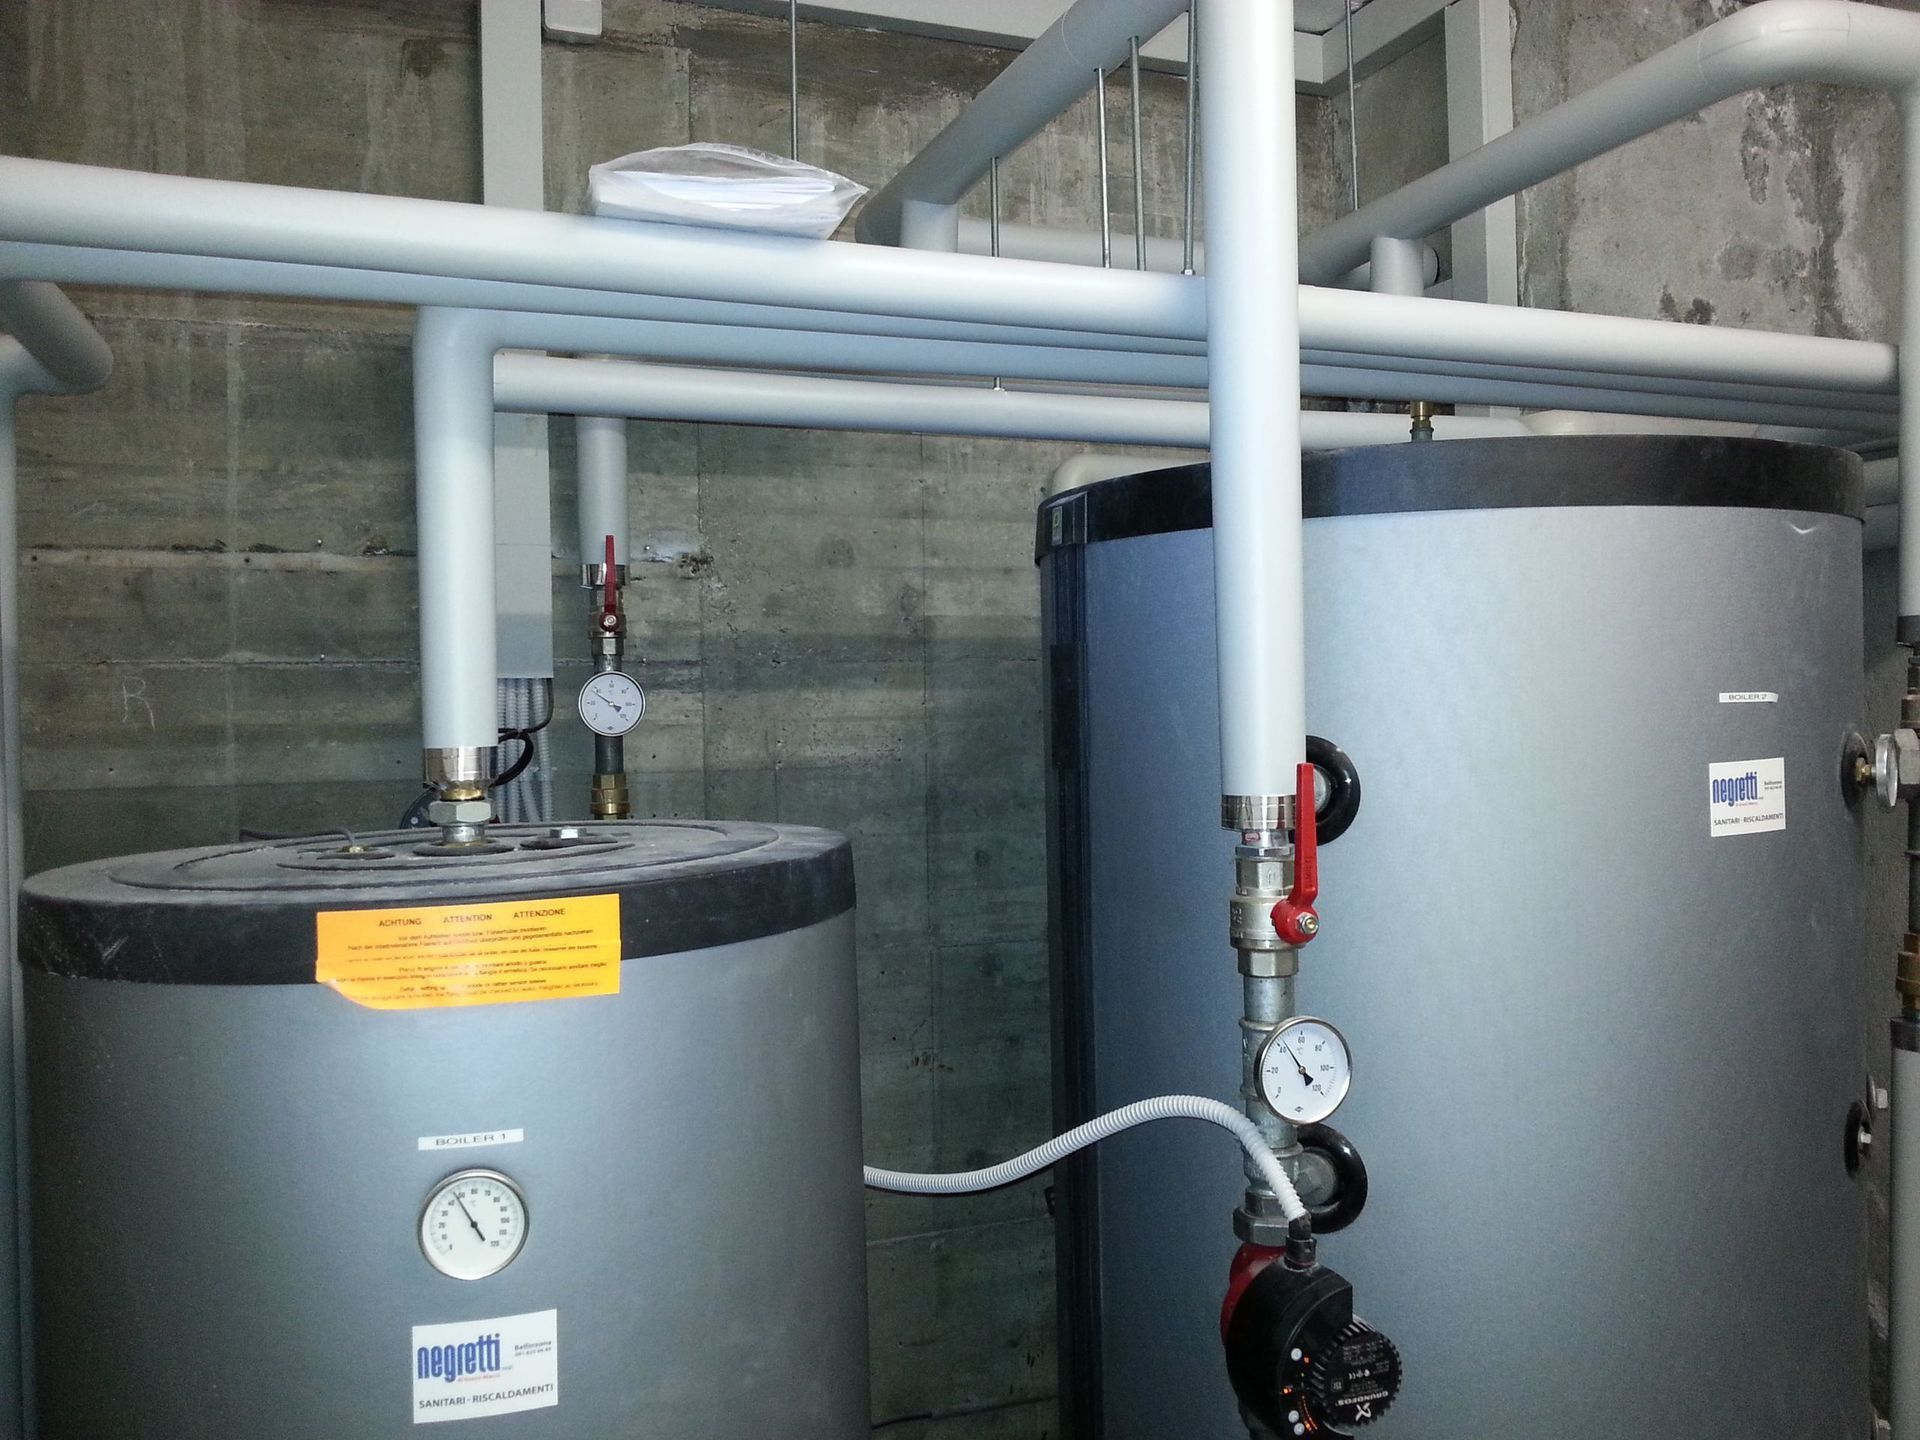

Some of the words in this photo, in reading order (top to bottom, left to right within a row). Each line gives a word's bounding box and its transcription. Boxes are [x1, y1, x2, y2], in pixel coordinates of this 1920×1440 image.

[1728, 693, 1760, 701] BOILER
[1712, 771, 1758, 807] negretti
[1714, 817, 1740, 826] SANITARI
[1743, 813, 1783, 823] RISCALDAMENTI
[379, 918, 421, 927] ACHTUNG
[443, 914, 493, 924] ATTENTION
[513, 908, 566, 919] ATTENZIONE
[1297, 1036, 1305, 1044] 60
[1315, 1044, 1322, 1052] 80
[435, 1134, 494, 1146] BOILER
[417, 1333, 500, 1383] negretti
[419, 1397, 465, 1408] SANITARI
[472, 1384, 553, 1403] RISCALDAMENTI
